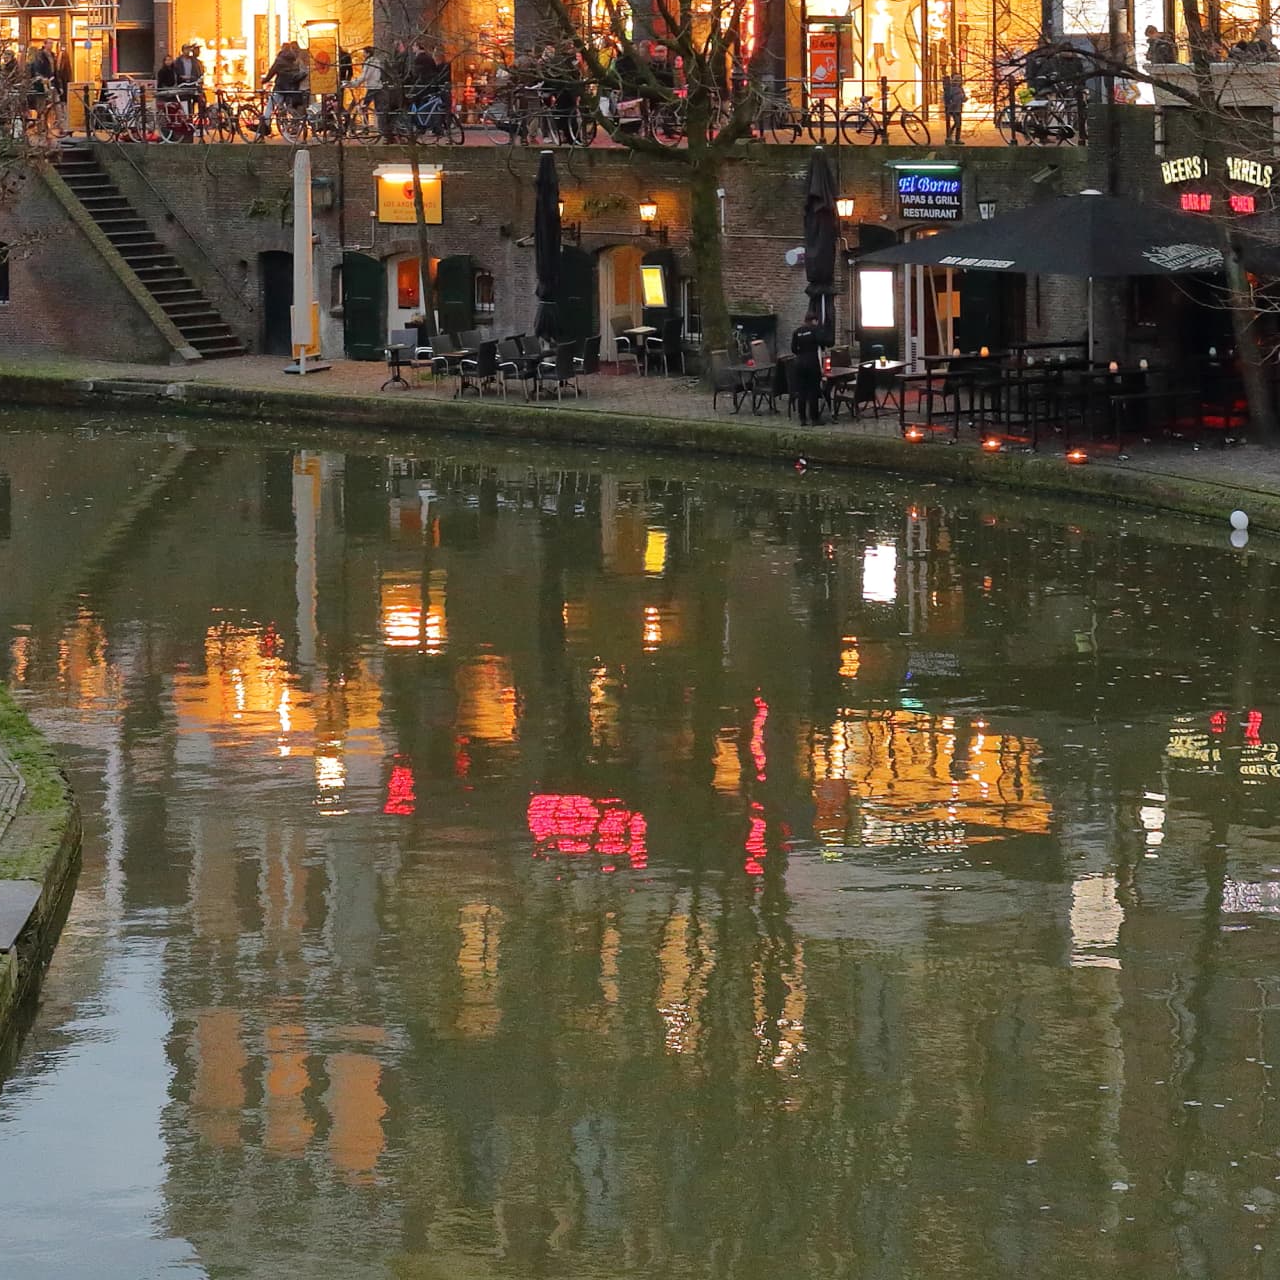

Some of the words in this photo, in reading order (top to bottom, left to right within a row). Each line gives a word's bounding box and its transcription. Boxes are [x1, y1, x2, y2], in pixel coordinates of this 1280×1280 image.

[1161, 155, 1202, 185] BEERS
[917, 177, 959, 193] Borne
[900, 194, 926, 205] TAPAS
[927, 195, 934, 205] &
[935, 195, 961, 206] GRILL
[903, 208, 958, 219] RESTAURANT
